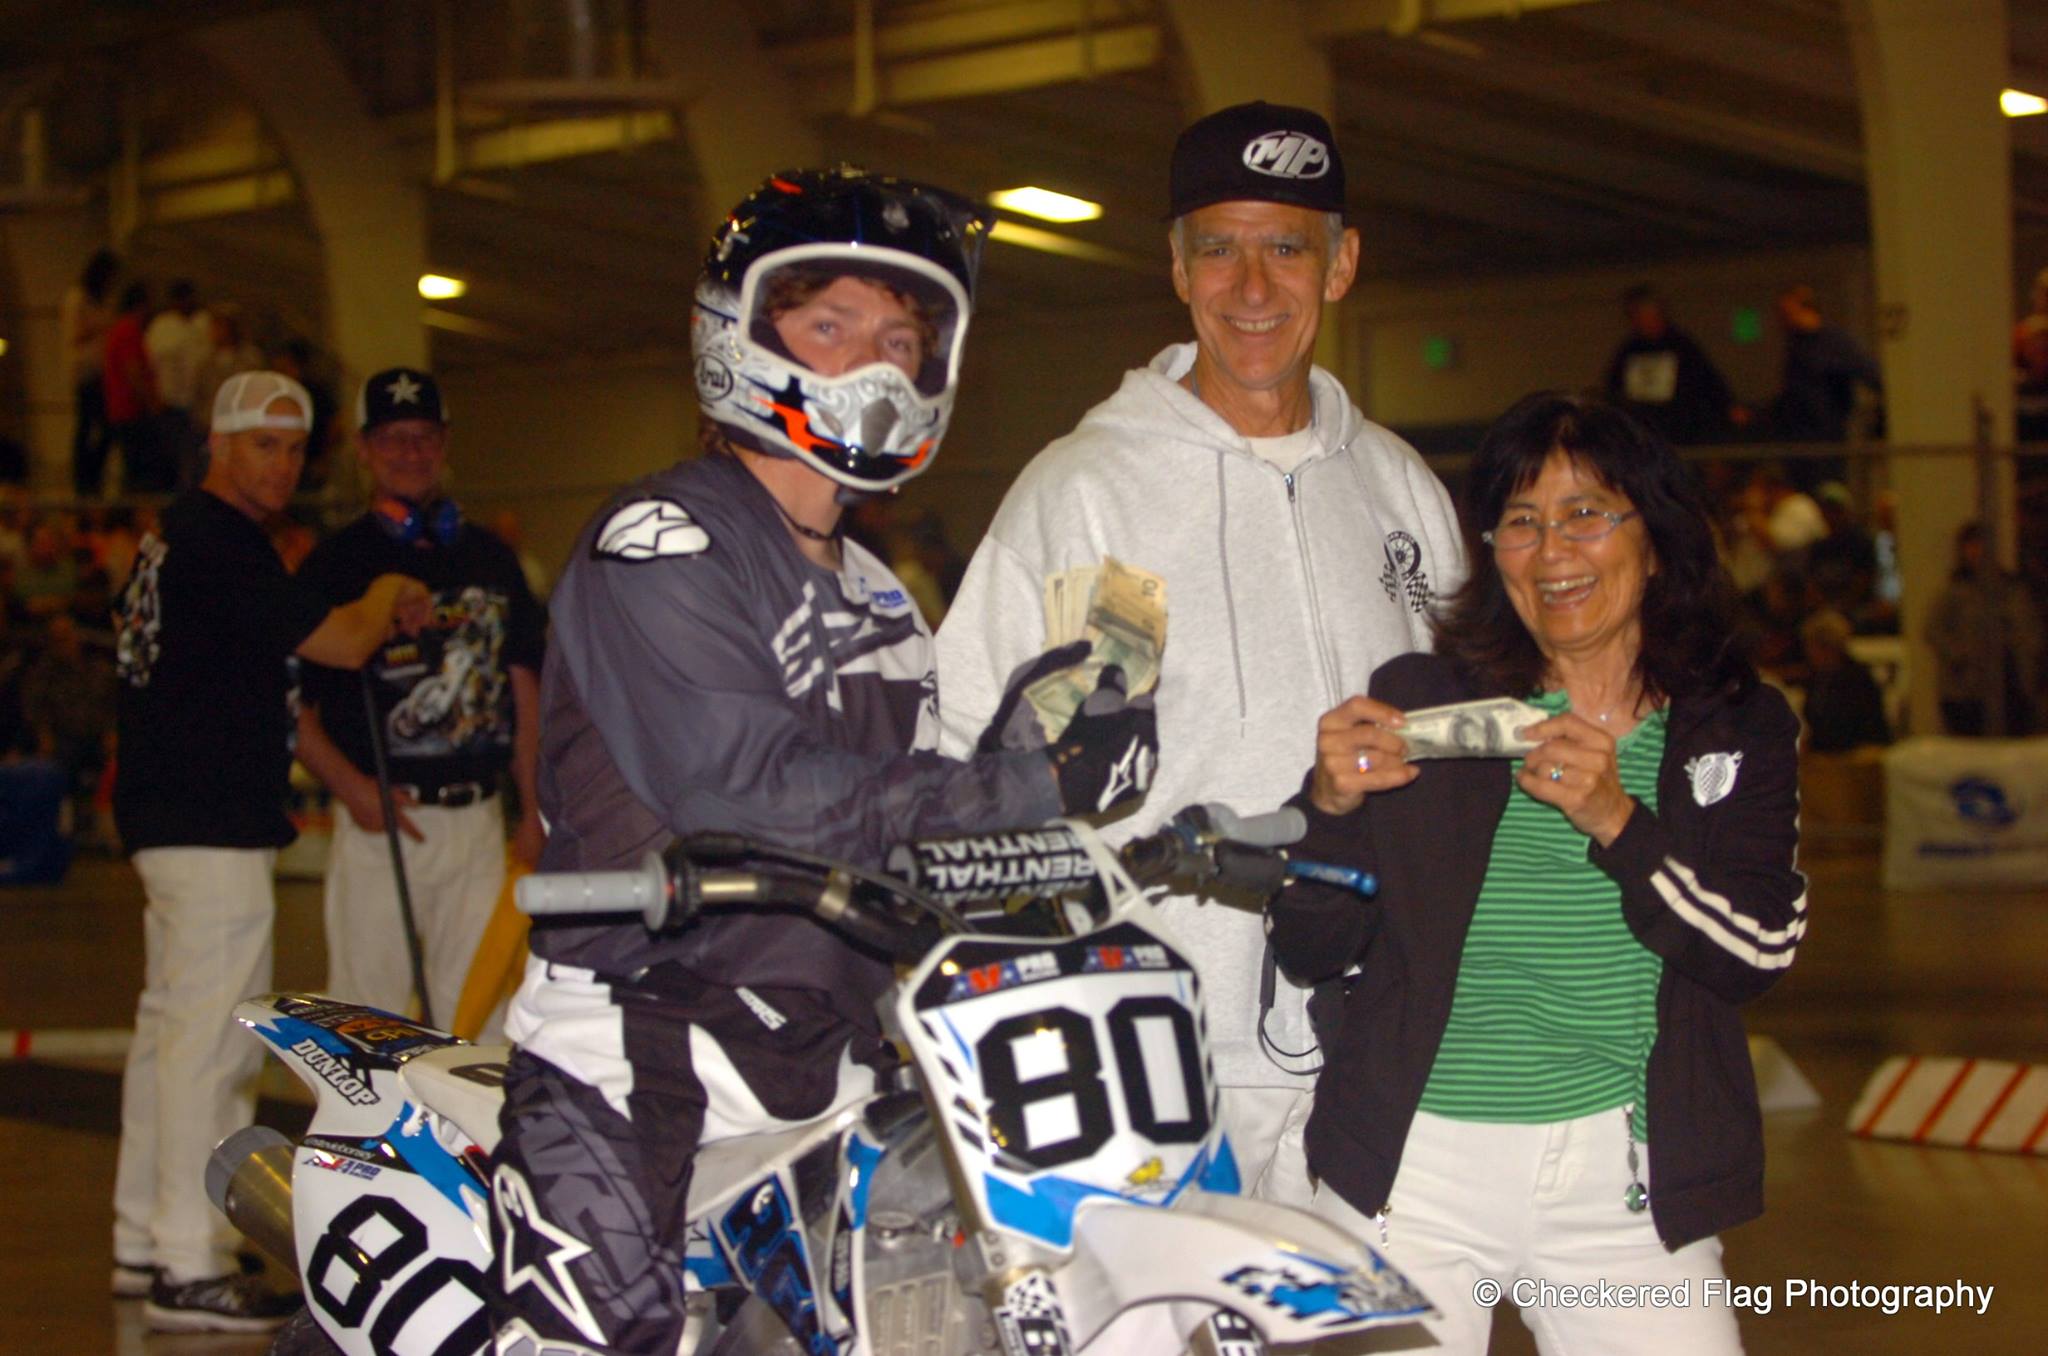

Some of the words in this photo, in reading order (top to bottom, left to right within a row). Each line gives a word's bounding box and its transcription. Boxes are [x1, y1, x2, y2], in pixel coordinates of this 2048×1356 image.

[1250, 136, 1327, 175] MP
[925, 853, 1097, 890] RENTHAL
[291, 1037, 381, 1107] DUNLOP
[976, 996, 1213, 1170] 80
[353, 1162, 382, 1176] PRO
[307, 1193, 491, 1356] 80
